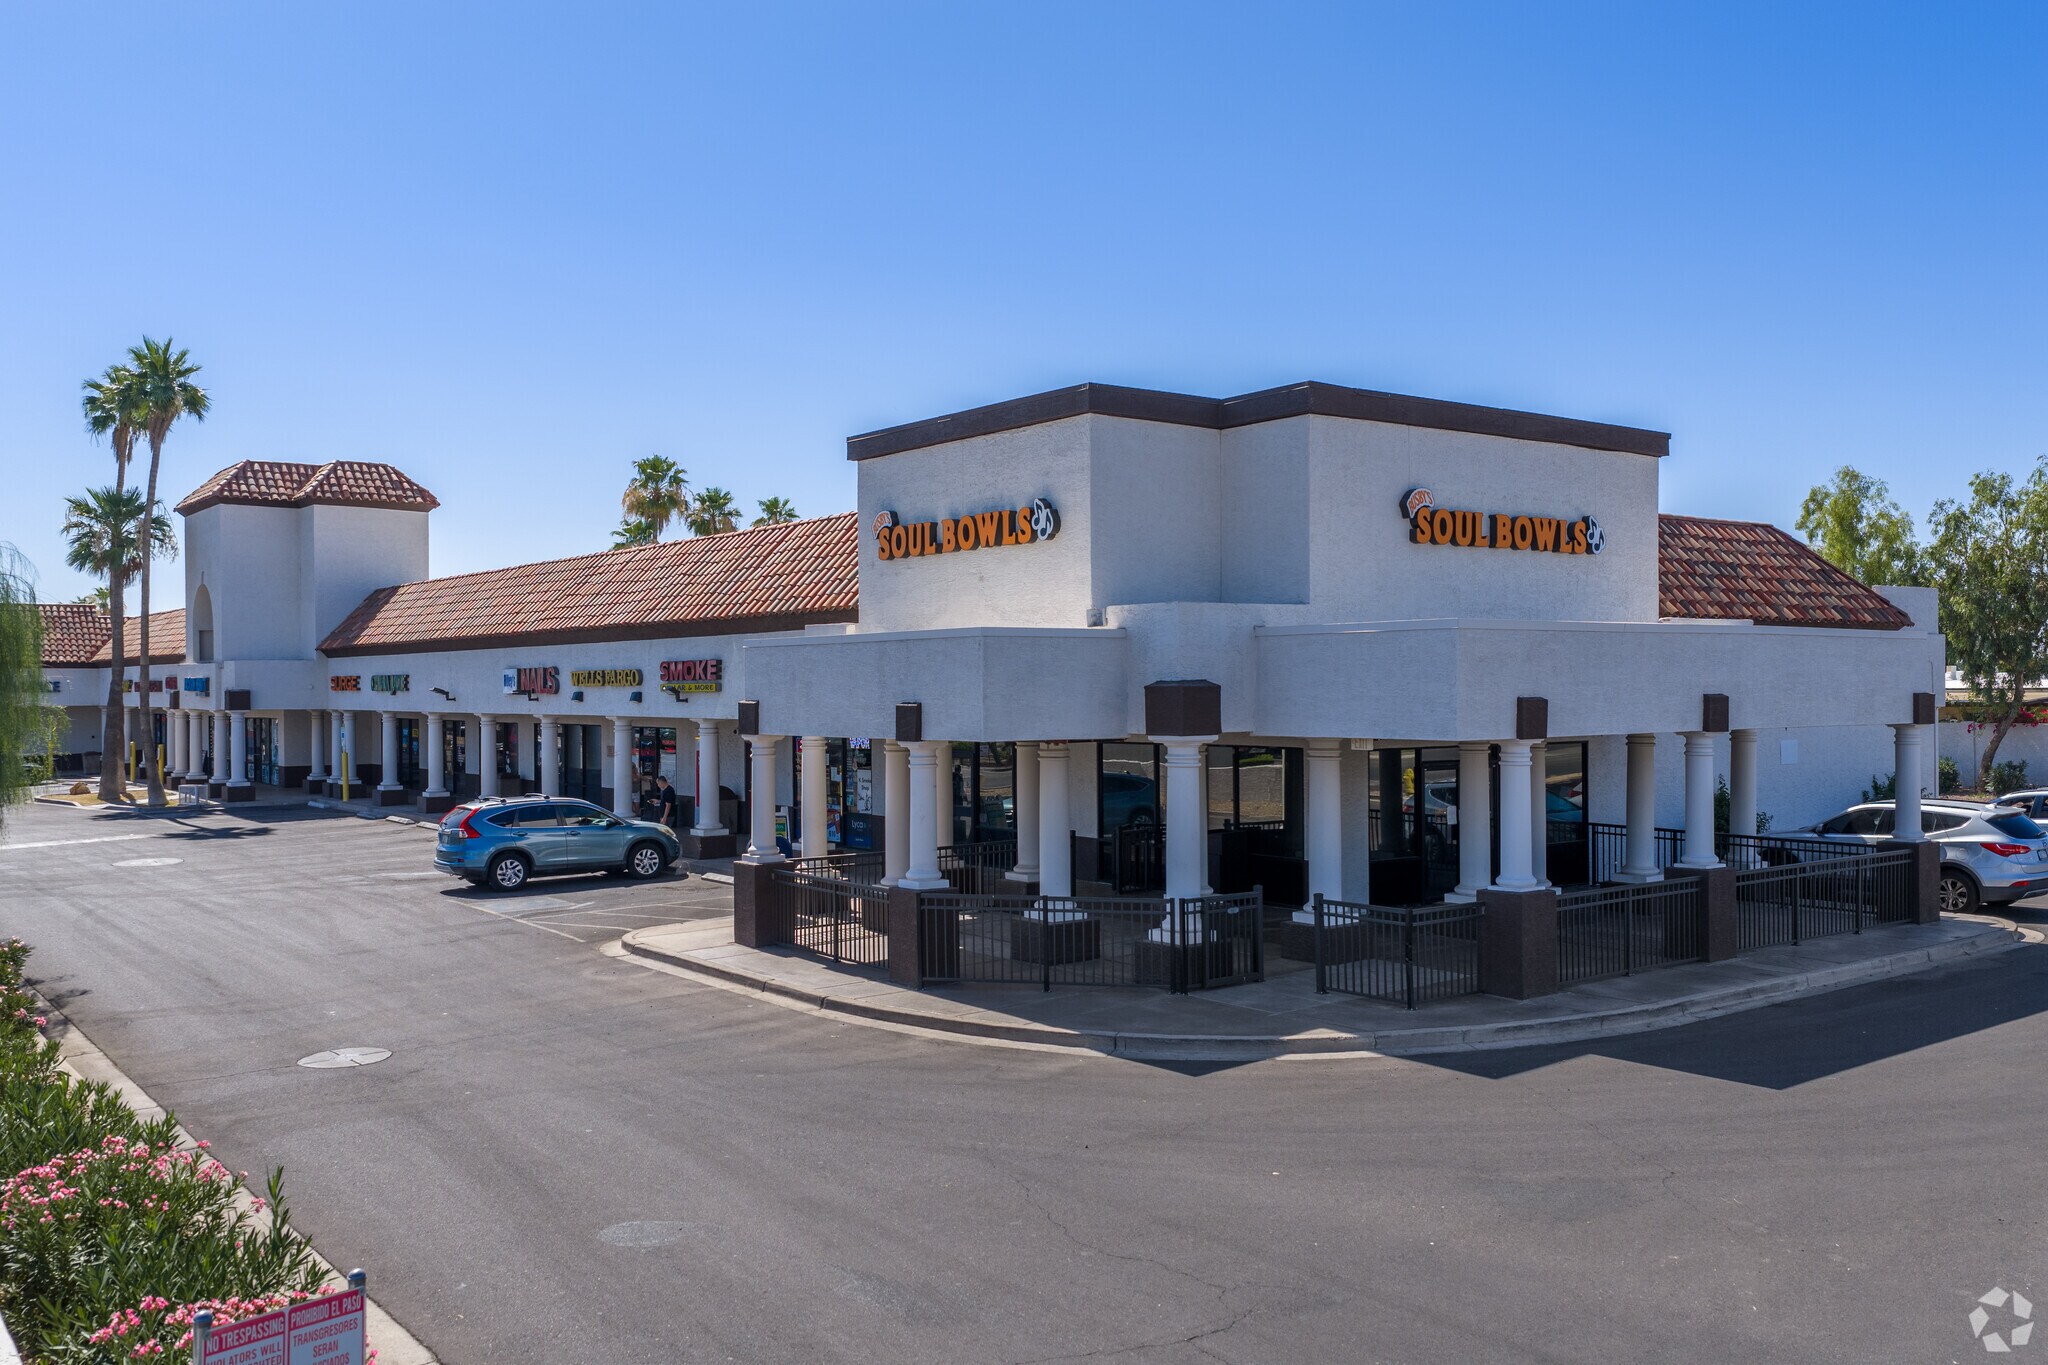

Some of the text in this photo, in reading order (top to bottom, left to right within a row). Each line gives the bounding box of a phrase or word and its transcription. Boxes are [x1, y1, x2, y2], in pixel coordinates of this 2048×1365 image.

[878, 506, 1033, 561] SOUL BOWLS
[1416, 506, 1588, 554] SOUL BOWLS
[331, 675, 358, 692] SURGE
[520, 666, 556, 694] NAILS
[571, 669, 639, 687] WELLS FARGO
[660, 659, 718, 681] SMOKE
[291, 1295, 361, 1328] PROHIBIDO EL PASO
[206, 1316, 285, 1354] NO TRESPASSING
[293, 1317, 359, 1347] TRANSGRESORES
[260, 1341, 283, 1357] WILL
[312, 1339, 339, 1358] SERAN
